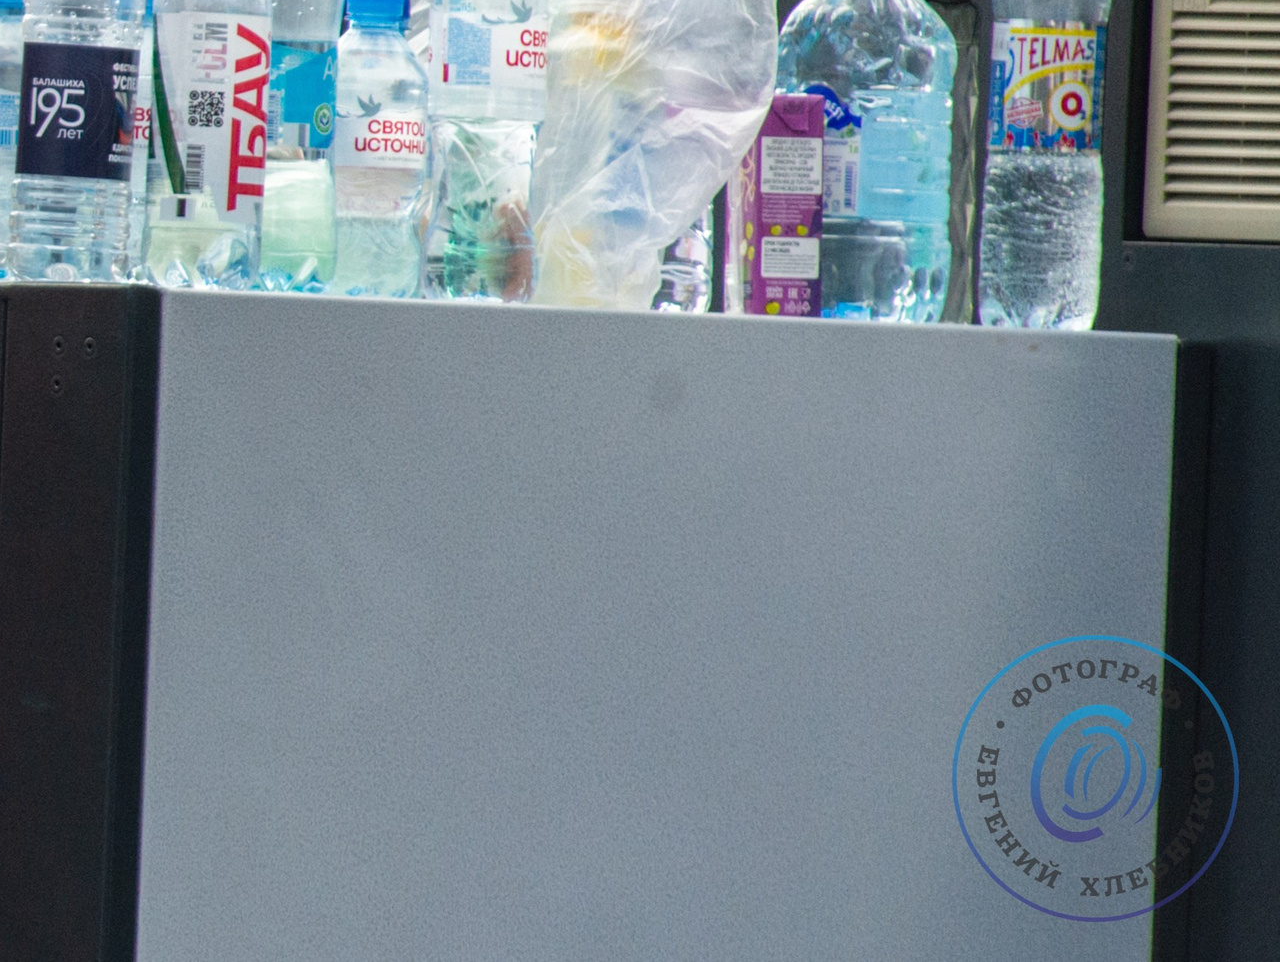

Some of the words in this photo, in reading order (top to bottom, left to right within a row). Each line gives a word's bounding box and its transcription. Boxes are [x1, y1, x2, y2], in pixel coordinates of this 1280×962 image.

[1005, 37, 1095, 89] STELMAS
[32, 77, 85, 88] БАЛАШИХА
[30, 87, 85, 138] 195
[57, 127, 84, 140] лет
